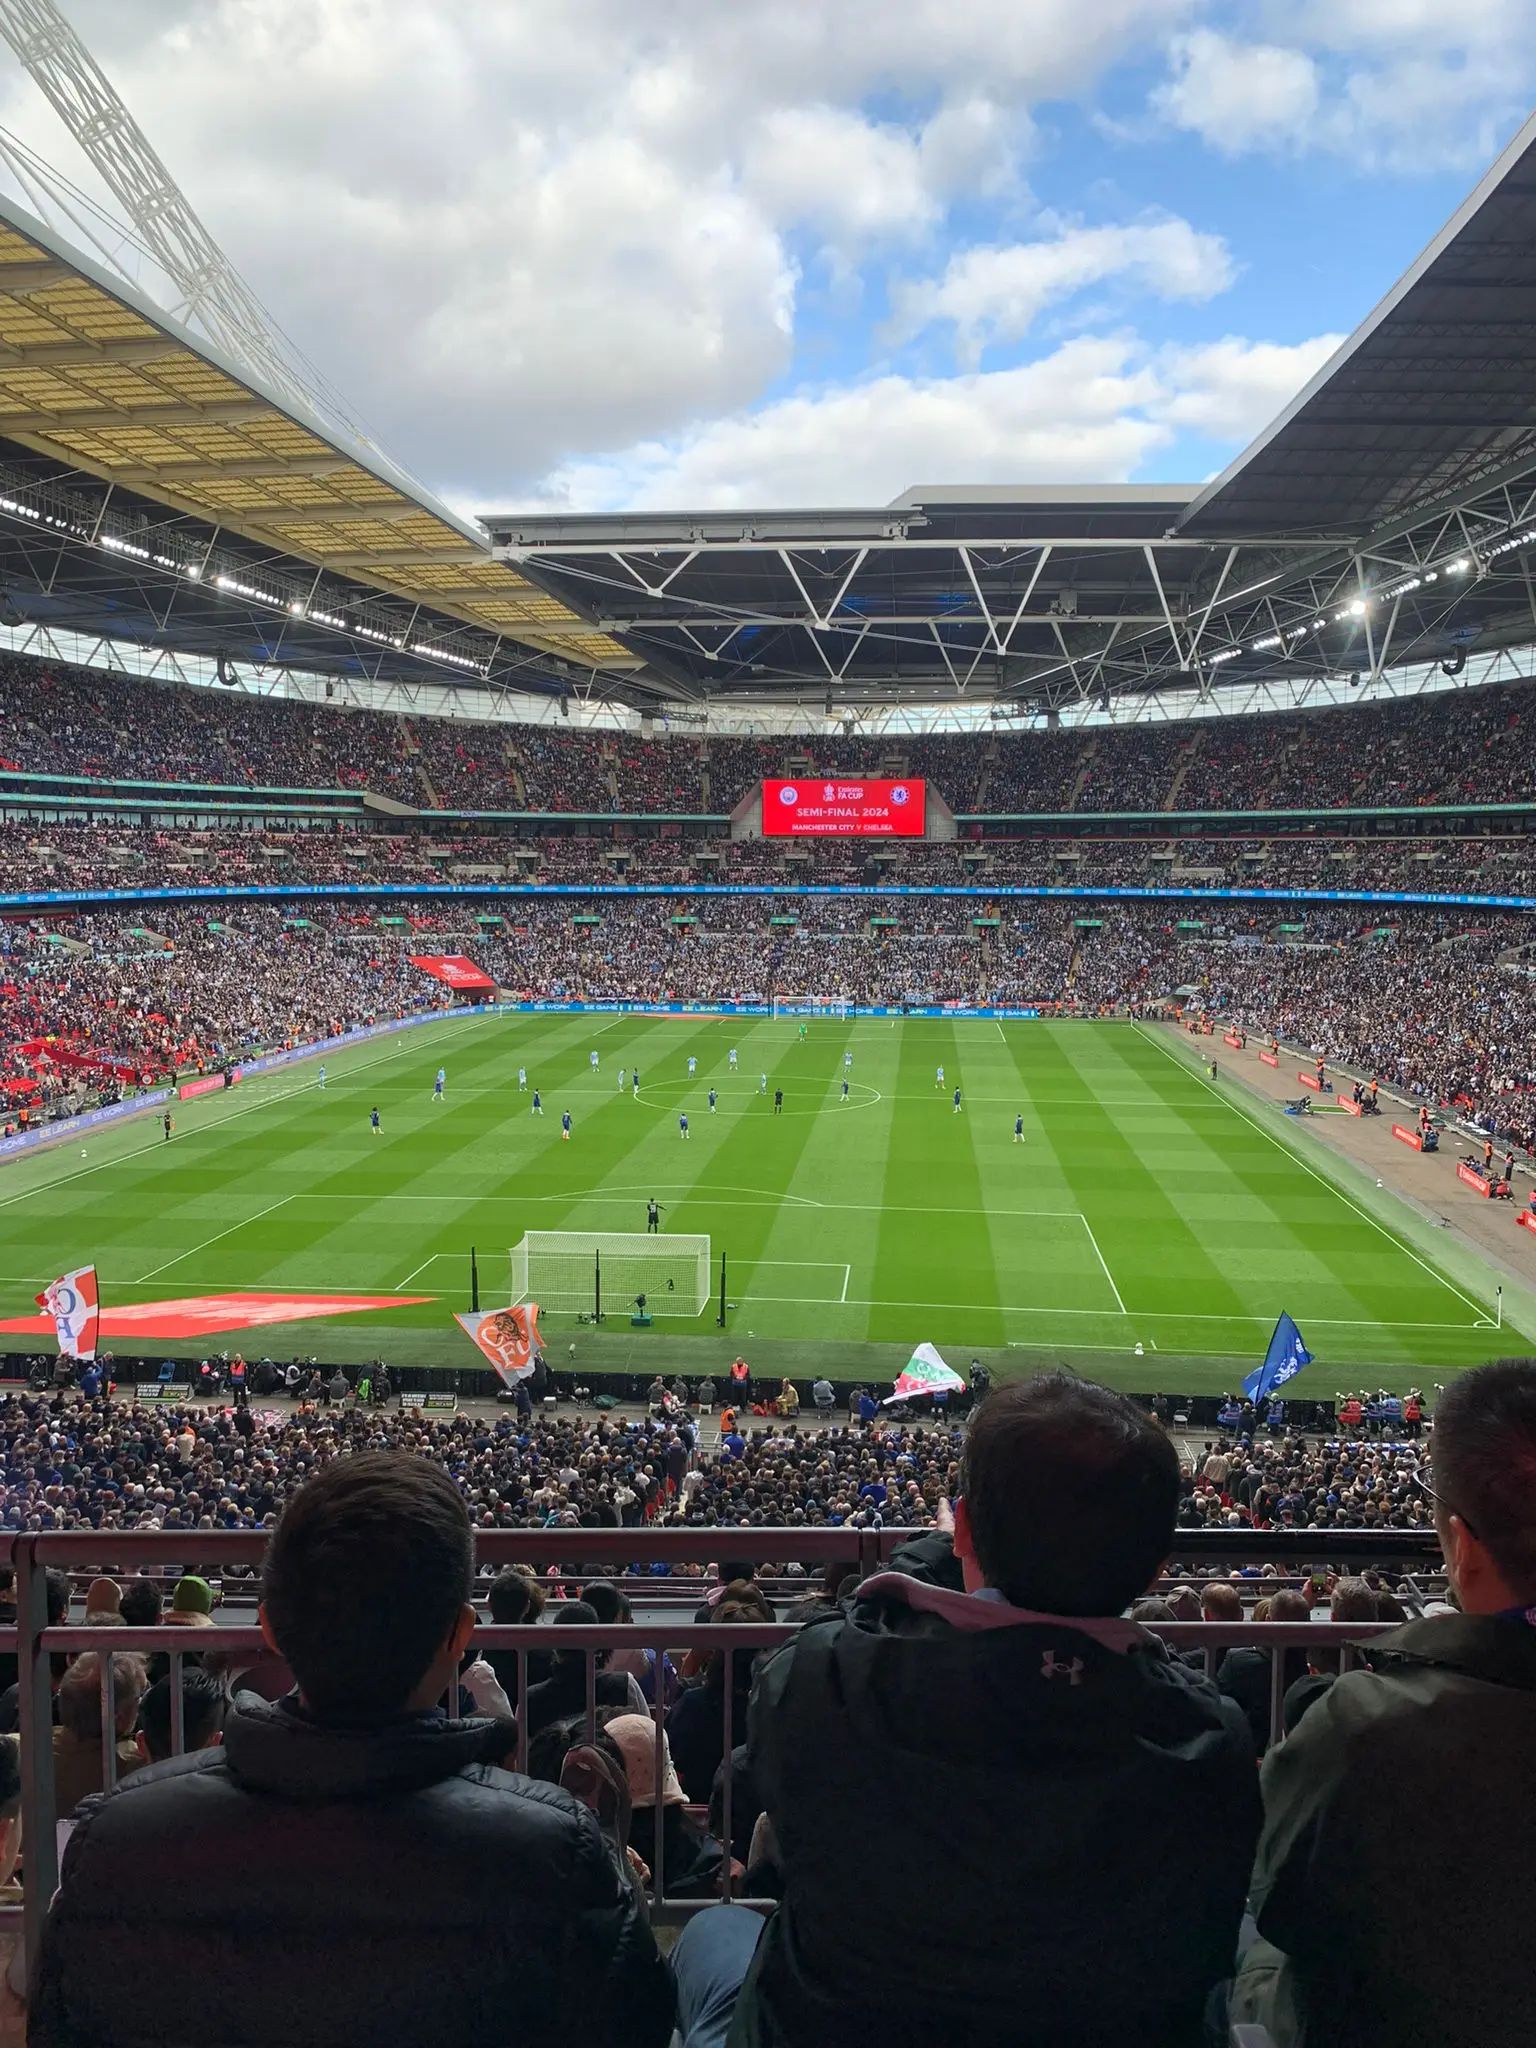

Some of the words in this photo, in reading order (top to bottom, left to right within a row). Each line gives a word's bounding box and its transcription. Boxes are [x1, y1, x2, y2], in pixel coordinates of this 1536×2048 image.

[797, 808, 859, 817] SEMI-FINAL
[862, 808, 889, 817] 2024
[52, 1120, 80, 1135] LEARN
